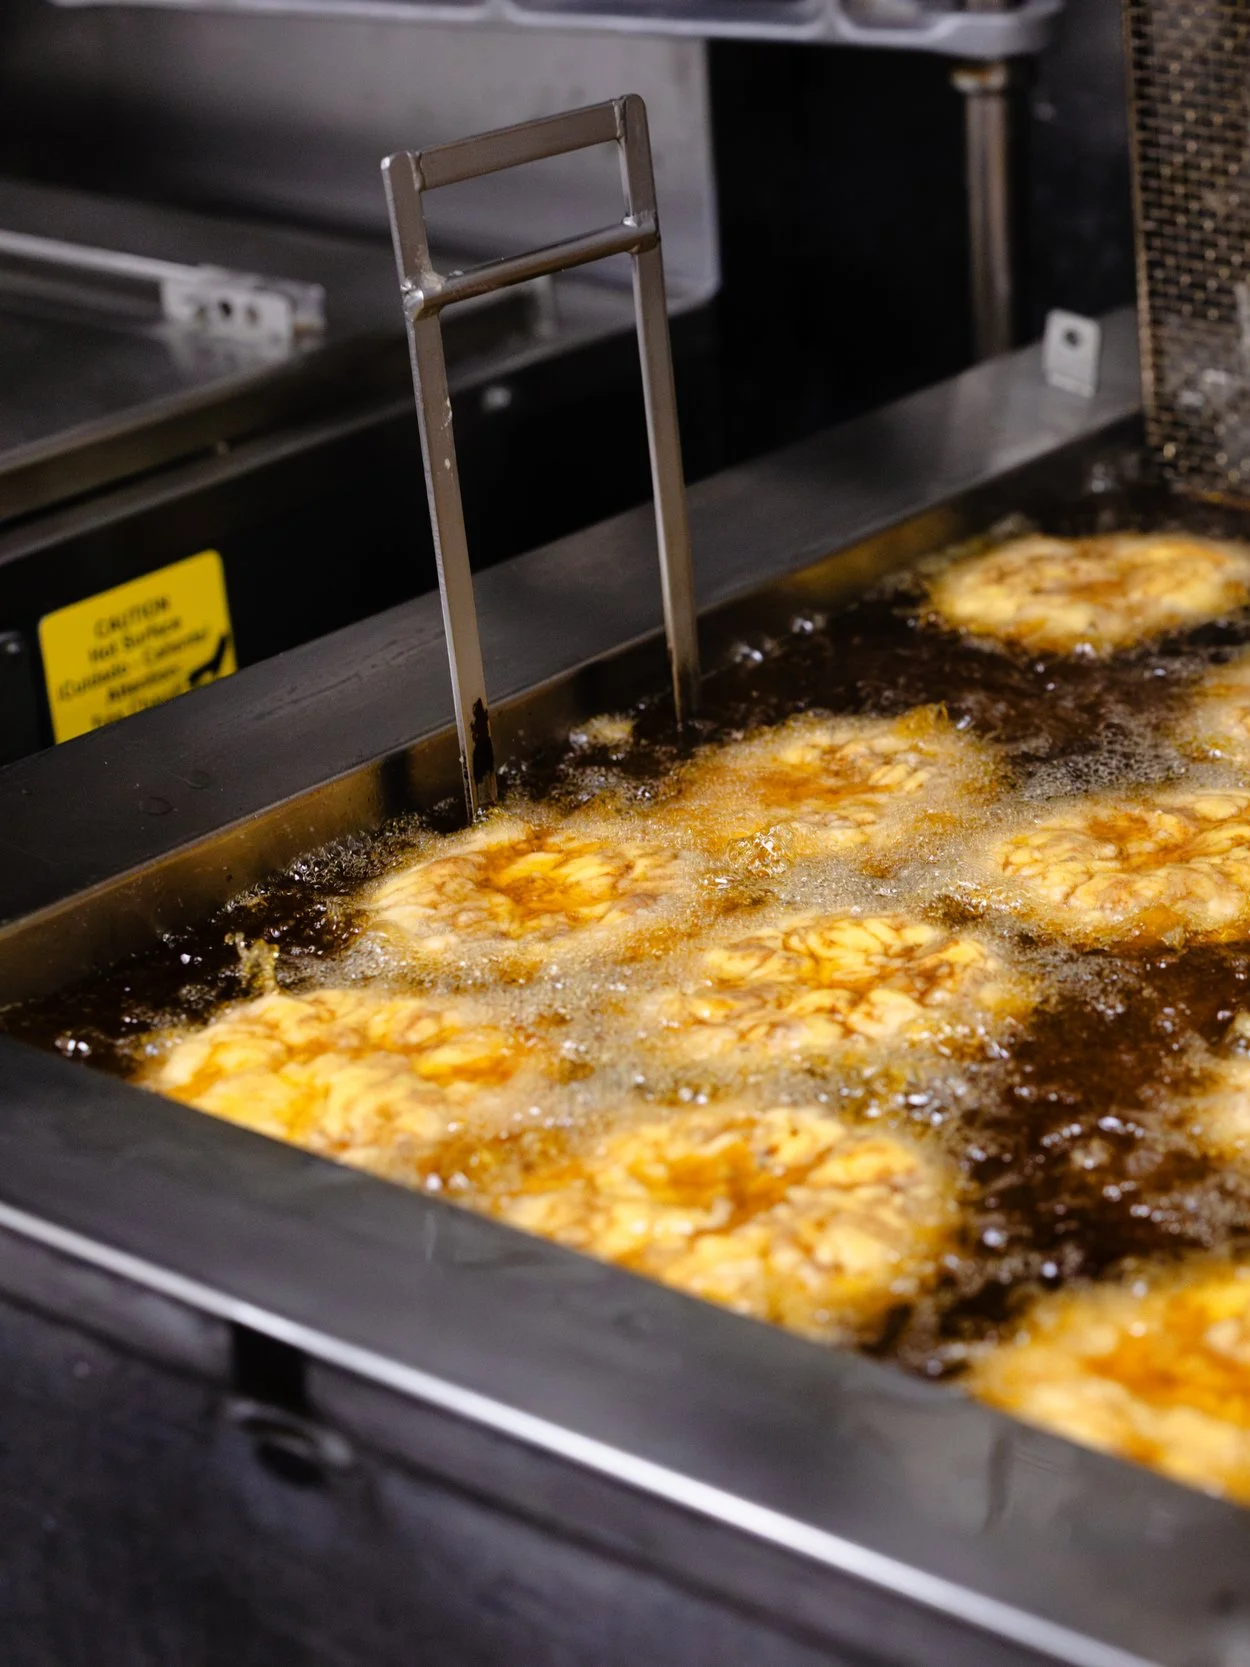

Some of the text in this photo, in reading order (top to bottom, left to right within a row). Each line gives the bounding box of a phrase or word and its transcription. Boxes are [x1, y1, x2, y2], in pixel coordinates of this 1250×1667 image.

[93, 596, 170, 638] CAUTION
[89, 617, 181, 664] Hot Surface
